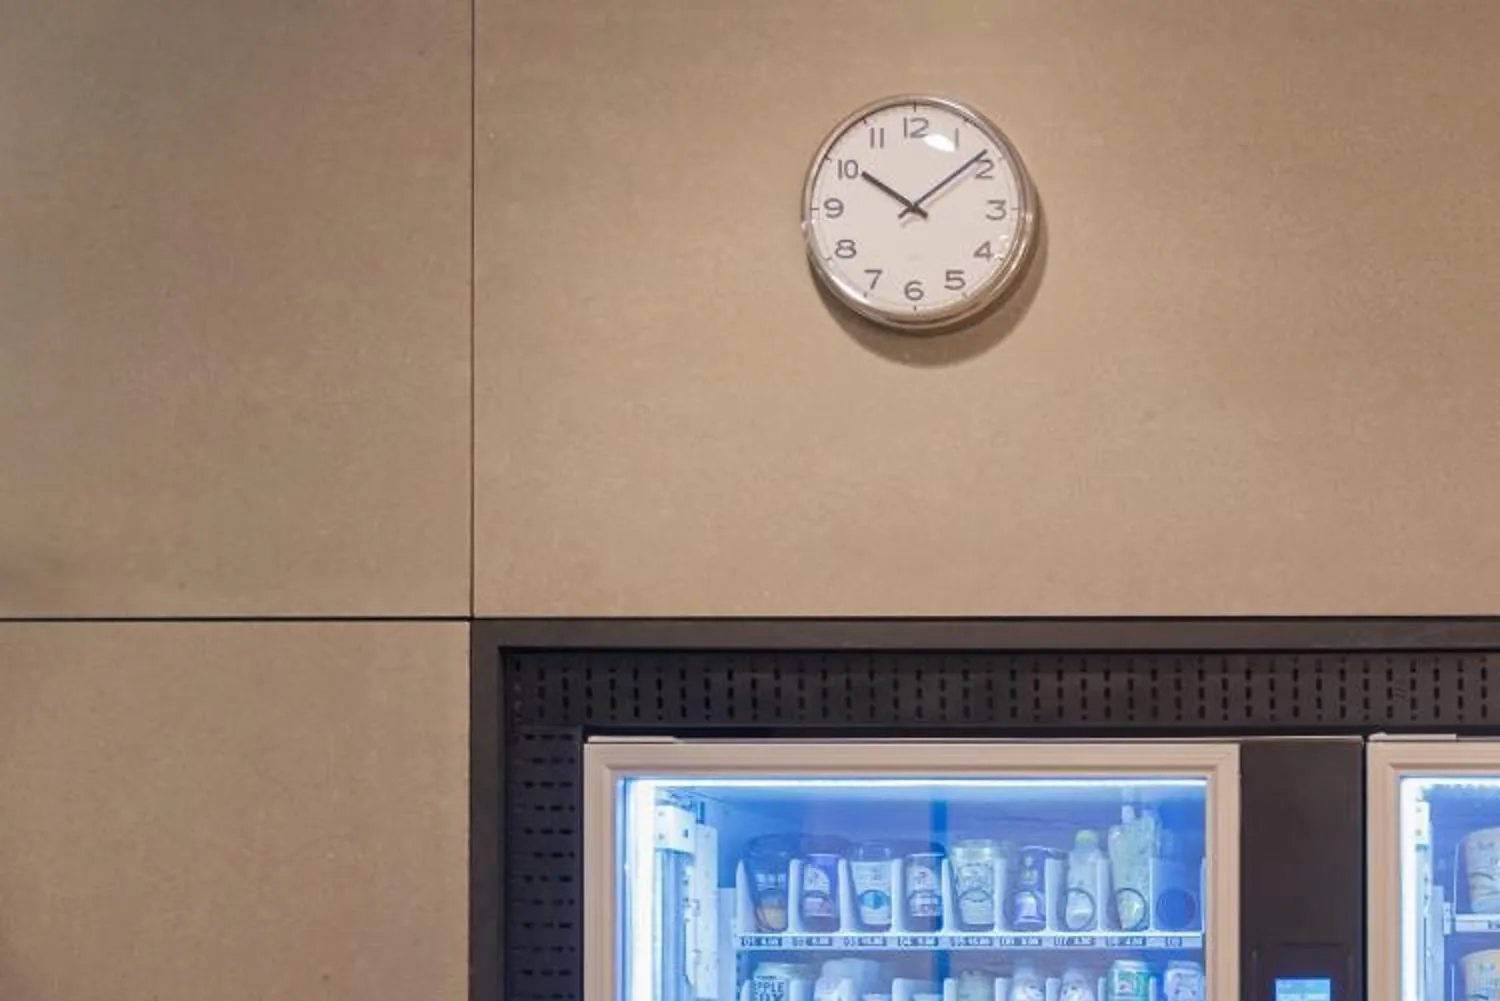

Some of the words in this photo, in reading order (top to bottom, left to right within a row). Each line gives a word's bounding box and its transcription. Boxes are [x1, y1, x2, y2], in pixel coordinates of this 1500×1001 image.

[870, 127, 884, 149] 11
[903, 117, 930, 139] 12
[955, 127, 960, 149] 1
[837, 159, 859, 180] 10
[974, 157, 994, 180] 2
[823, 198, 844, 219] 9
[986, 199, 1007, 221] 3
[834, 238, 857, 259] 8
[973, 240, 993, 261] 4
[864, 268, 883, 290] 7
[944, 269, 966, 291] 5
[904, 280, 925, 301] 6
